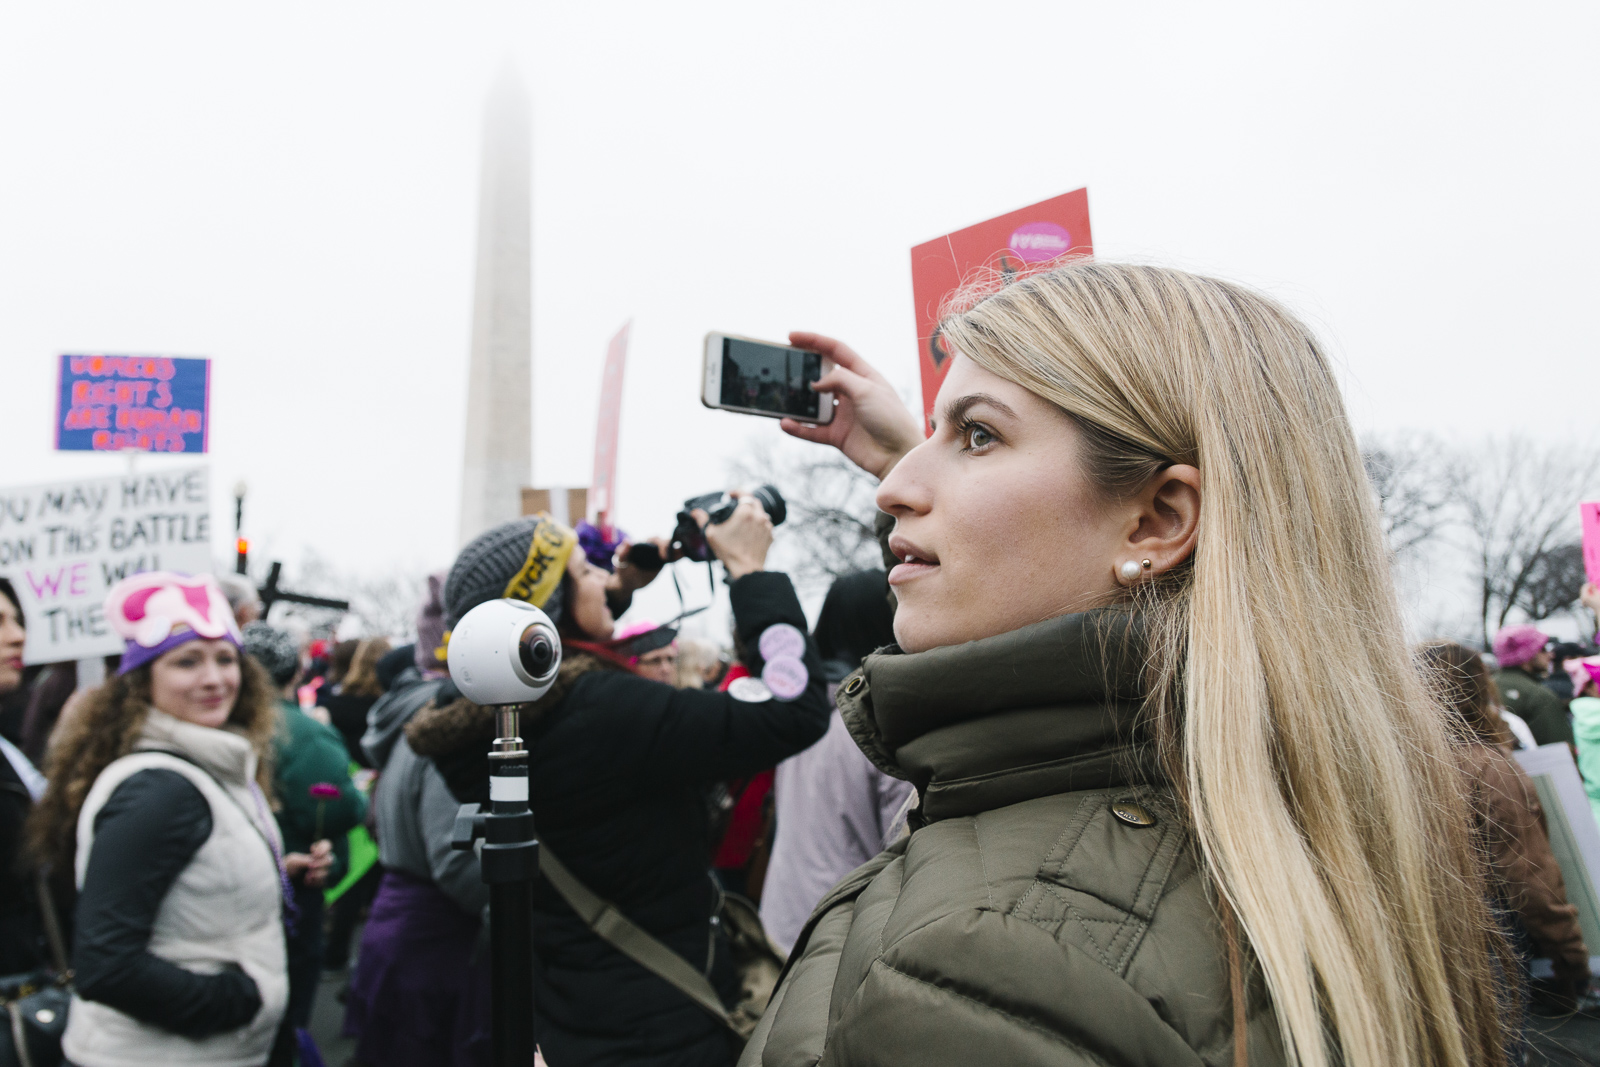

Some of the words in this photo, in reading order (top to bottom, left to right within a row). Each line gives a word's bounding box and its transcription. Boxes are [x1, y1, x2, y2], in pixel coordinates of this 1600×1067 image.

[64, 406, 110, 430] ARE
[115, 408, 201, 433] HUMAN
[38, 485, 108, 521] MAY
[119, 471, 205, 509] HAVE
[109, 514, 210, 551] BATTLE
[25, 562, 89, 600] WE
[45, 604, 107, 642] THE
